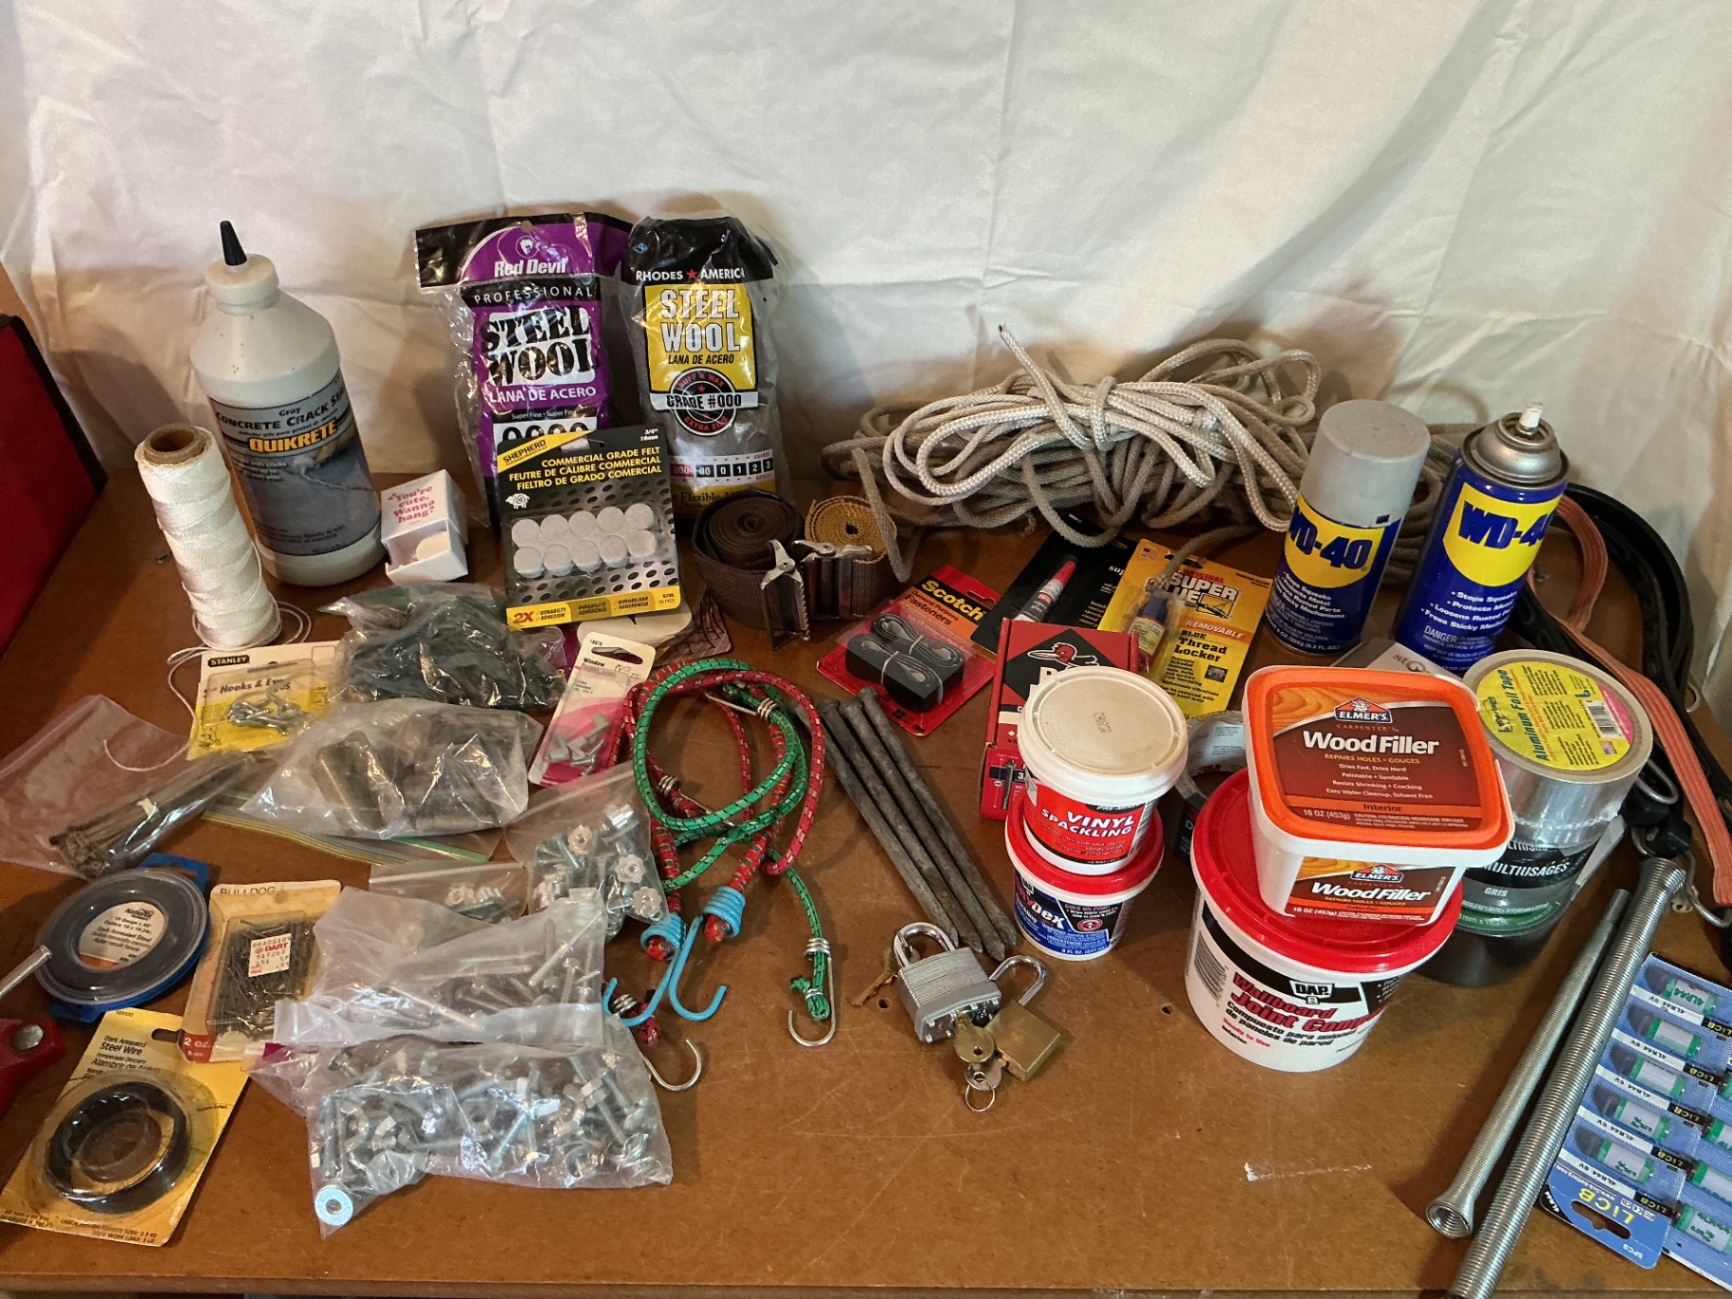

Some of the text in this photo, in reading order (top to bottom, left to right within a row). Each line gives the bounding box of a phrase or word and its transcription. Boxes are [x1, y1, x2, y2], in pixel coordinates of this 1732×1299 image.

[494, 258, 567, 278] Red Devil
[636, 270, 683, 281] RHODES
[474, 286, 593, 304] PROFESSIONAL
[660, 288, 740, 320] STEEL
[480, 305, 590, 352] STEEL
[660, 322, 741, 353] WOOL
[487, 338, 595, 385] WOOL
[668, 354, 734, 365] LANA DE ACERO
[708, 373, 725, 388] WAX
[490, 387, 597, 404] LANA DE ACERO
[666, 394, 742, 409] GRADE #000
[216, 411, 281, 430] CONCRETE
[286, 402, 329, 426] CRACK
[279, 407, 301, 417] Gray
[512, 411, 529, 420] Super
[530, 410, 542, 419] Fine
[546, 409, 564, 418] Super
[684, 416, 709, 431] EXTRA
[248, 419, 337, 454] QUIKRETE
[503, 440, 546, 464] SHEPHERD
[541, 453, 604, 468] COMMERCIAL
[606, 449, 639, 460] GRADE
[641, 446, 660, 455] FELT
[509, 456, 662, 482] FEUTRE DE CALIBRE COMMERCIAL
[720, 466, 726, 475] 0
[752, 464, 758, 472] 2
[766, 461, 771, 469] 3
[517, 465, 662, 490] FIELTRO DE GRADO COMERCIAL
[393, 500, 435, 517] Wanna
[398, 496, 429, 508] cute.
[398, 506, 435, 523] hang?
[1458, 500, 1554, 550] WD-4
[1183, 569, 1224, 583] ORIGINAL
[1170, 572, 1239, 601] SUPER
[911, 590, 959, 622] General Purpose
[921, 579, 984, 621] Scotch
[1452, 600, 1492, 612] Protects
[1456, 591, 1484, 604] Stops
[513, 611, 535, 624] 2X
[904, 594, 952, 626] Fasteners
[1434, 603, 1502, 621] Loosens Rusted
[1185, 619, 1245, 640] REMOVABLE
[1424, 609, 1478, 632] Frees Sticky
[1181, 629, 1207, 640] BLUE
[1424, 625, 1458, 643] DANGER
[1174, 644, 1222, 662] Locker
[1179, 637, 1228, 655] Thread
[210, 655, 248, 666] STANLEY
[583, 657, 606, 668] Window
[220, 680, 262, 694] Hooks &
[1497, 669, 1515, 690] Tape
[1505, 691, 1525, 711] Foil
[1339, 711, 1388, 720] ELMER'S
[1336, 723, 1396, 732] CARPENTER'S
[1303, 730, 1440, 755] Wood Filler
[1517, 712, 1550, 762] Aluminum
[1324, 753, 1356, 761] REPAIRS
[1356, 755, 1382, 763] HOLES
[1325, 787, 1341, 795] Easy
[1332, 779, 1423, 791] Resists Shrinking Cracking
[1303, 809, 1312, 817] 16
[1314, 810, 1325, 818] OZ
[1326, 810, 1351, 821] (453g)
[1363, 803, 1403, 812] Interior
[1041, 808, 1133, 839] SPACKLING
[1066, 810, 1135, 829] VINYL
[1354, 872, 1400, 881] ELMER'S
[1311, 881, 1432, 901] Wood Filler
[1484, 887, 1509, 897] GRIS
[264, 942, 289, 952] DART
[1232, 971, 1339, 1019] Wallboard
[1230, 991, 1300, 1029] Joint
[1649, 996, 1686, 1015] 4LR44 6V
[1225, 1007, 1335, 1046] de paneles de pared
[1227, 1000, 1285, 1035] Compuesto
[1286, 1031, 1315, 1040] para
[183, 1037, 191, 1046] 2
[1221, 1024, 1248, 1045] Interior
[1223, 1017, 1271, 1048] Ready to Use
[100, 1041, 143, 1056] Steel Wire
[120, 1038, 147, 1048] Annealed
[91, 1058, 125, 1070] Alambre
[1630, 1039, 1714, 1082] LiCB 4LR44 6V
[1614, 1077, 1699, 1121] LiCB 4LR44 6V
[1597, 1119, 1684, 1167] LiCB 4LR44 6V
[1578, 1162, 1667, 1214] LiCB 4LR44 6V
[1578, 1187, 1635, 1225] LiCB
